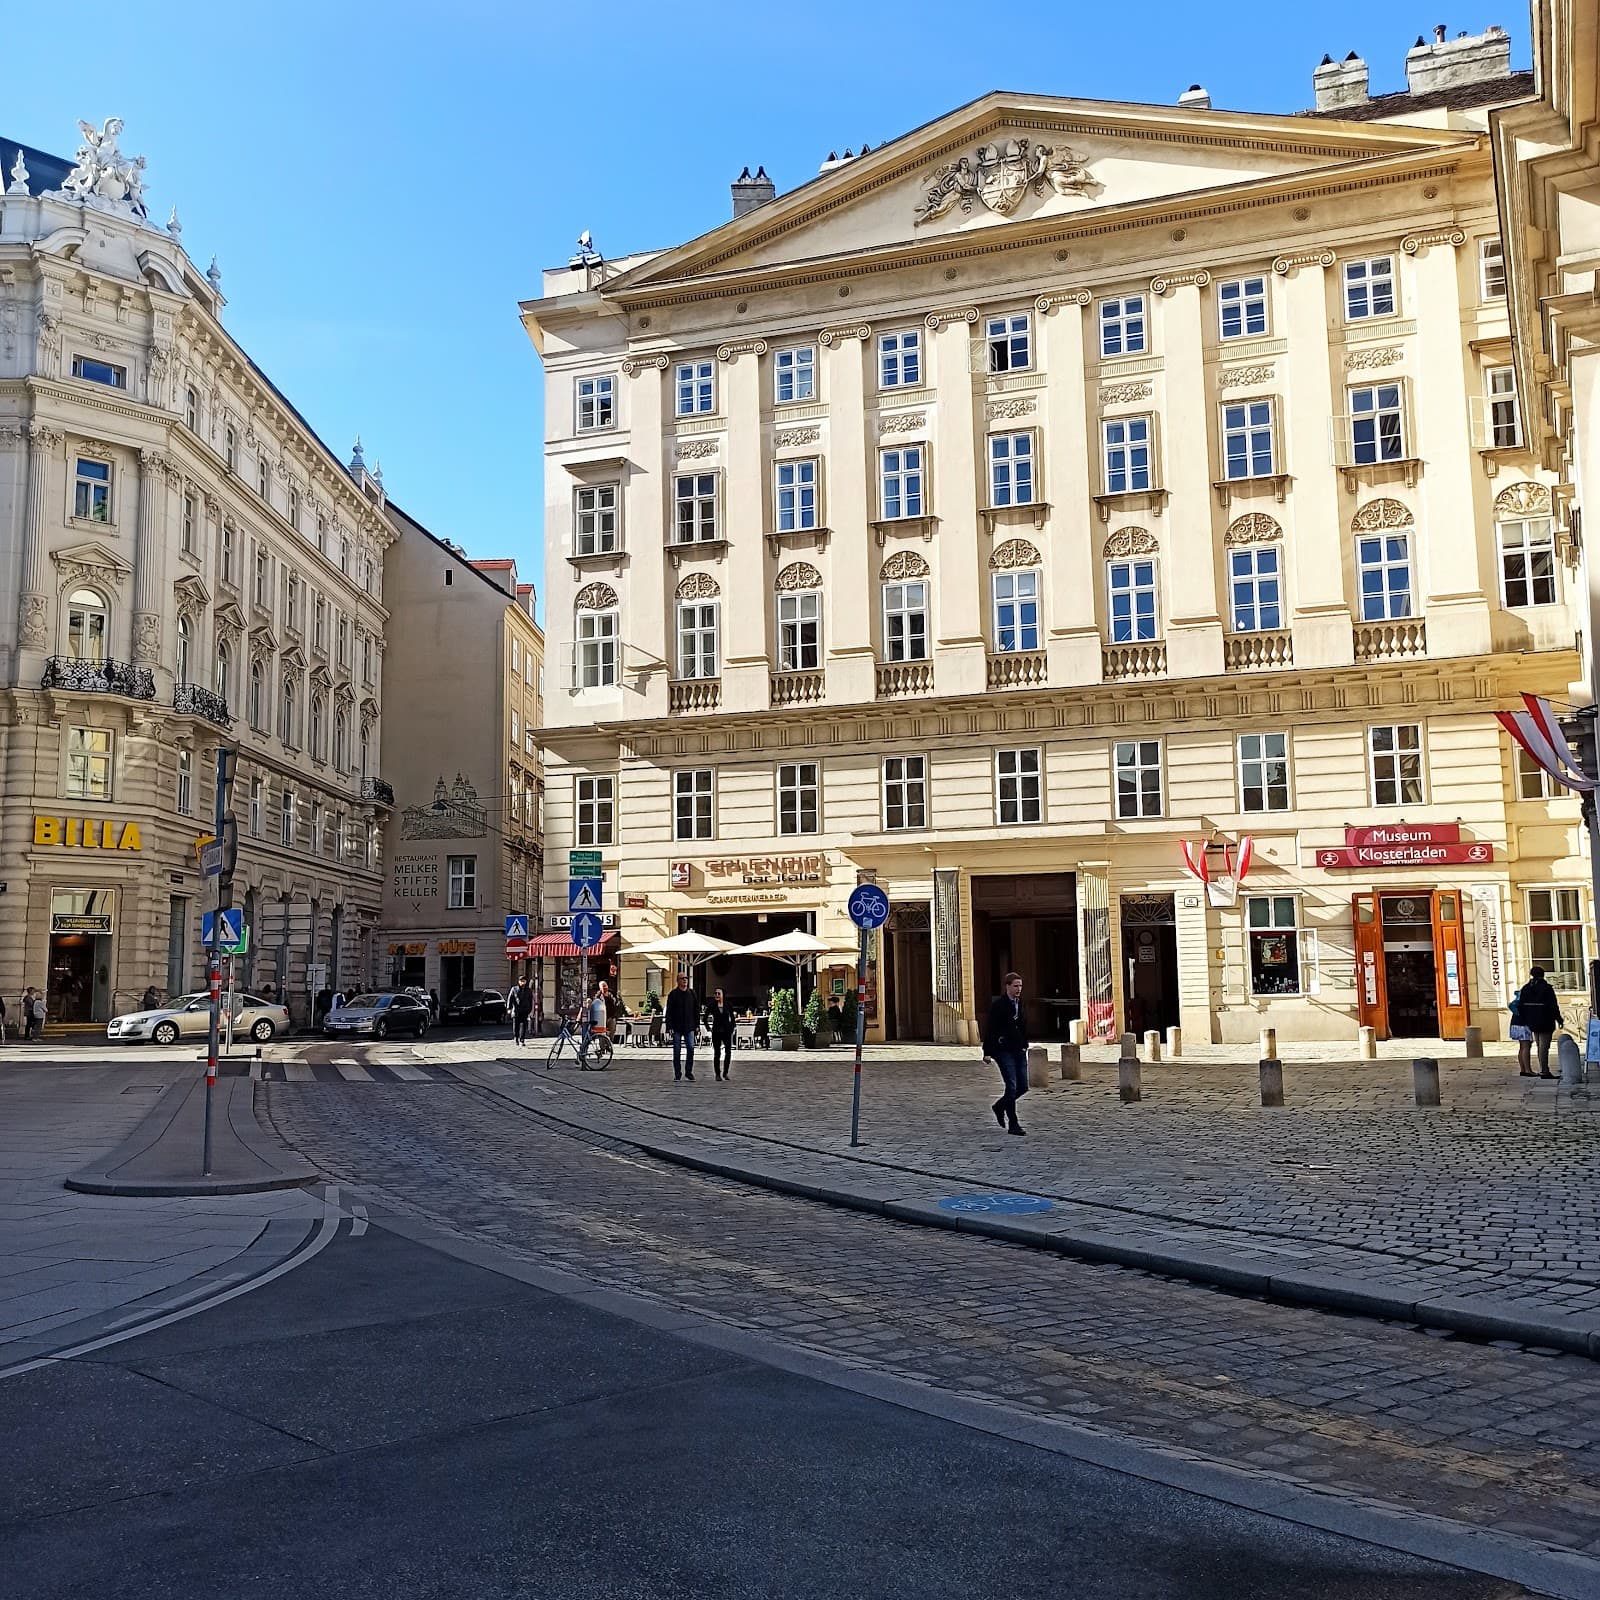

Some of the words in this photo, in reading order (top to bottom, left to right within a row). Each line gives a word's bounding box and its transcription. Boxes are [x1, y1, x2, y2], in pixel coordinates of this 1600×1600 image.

[34, 815, 142, 850] BILLA
[1373, 829, 1432, 843] Museum
[394, 854, 438, 862] RESTAURANT
[1358, 846, 1447, 861] Klosterladen
[394, 863, 438, 874] MELKER
[393, 875, 438, 886] STIFTS
[743, 875, 772, 884] bar
[777, 872, 819, 884] italia
[394, 887, 438, 897] KELLER
[1481, 909, 1488, 918] im
[1481, 920, 1490, 948] Museum
[388, 943, 428, 955] NGY
[438, 940, 476, 954] HÜTE
[1489, 917, 1501, 986] SCHOTTENSTIFT
[937, 950, 948, 987] Dialog
